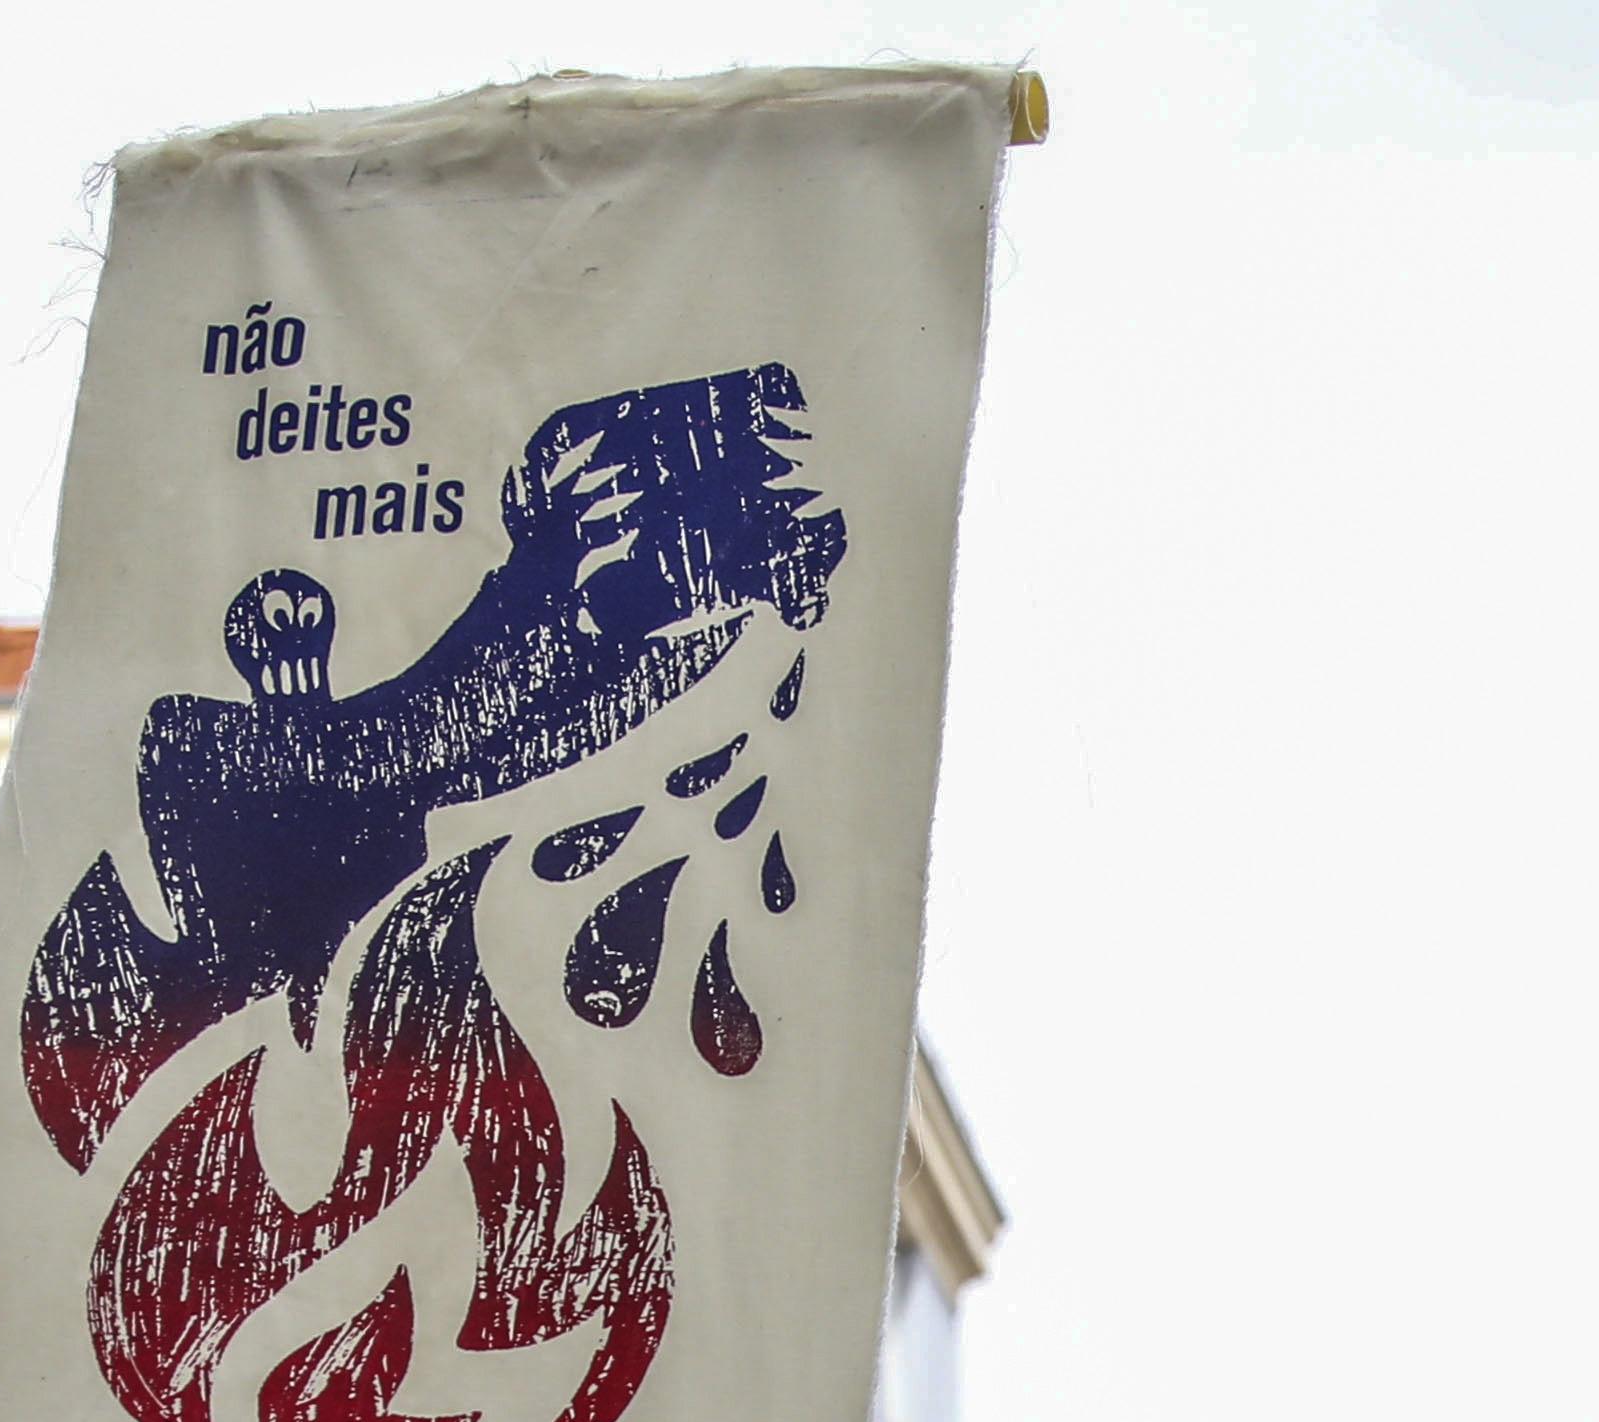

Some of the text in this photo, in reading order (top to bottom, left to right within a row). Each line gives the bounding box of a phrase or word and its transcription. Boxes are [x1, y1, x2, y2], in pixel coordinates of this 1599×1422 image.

[203, 301, 306, 375] não
[236, 384, 412, 461] deites
[314, 463, 465, 540] mais
